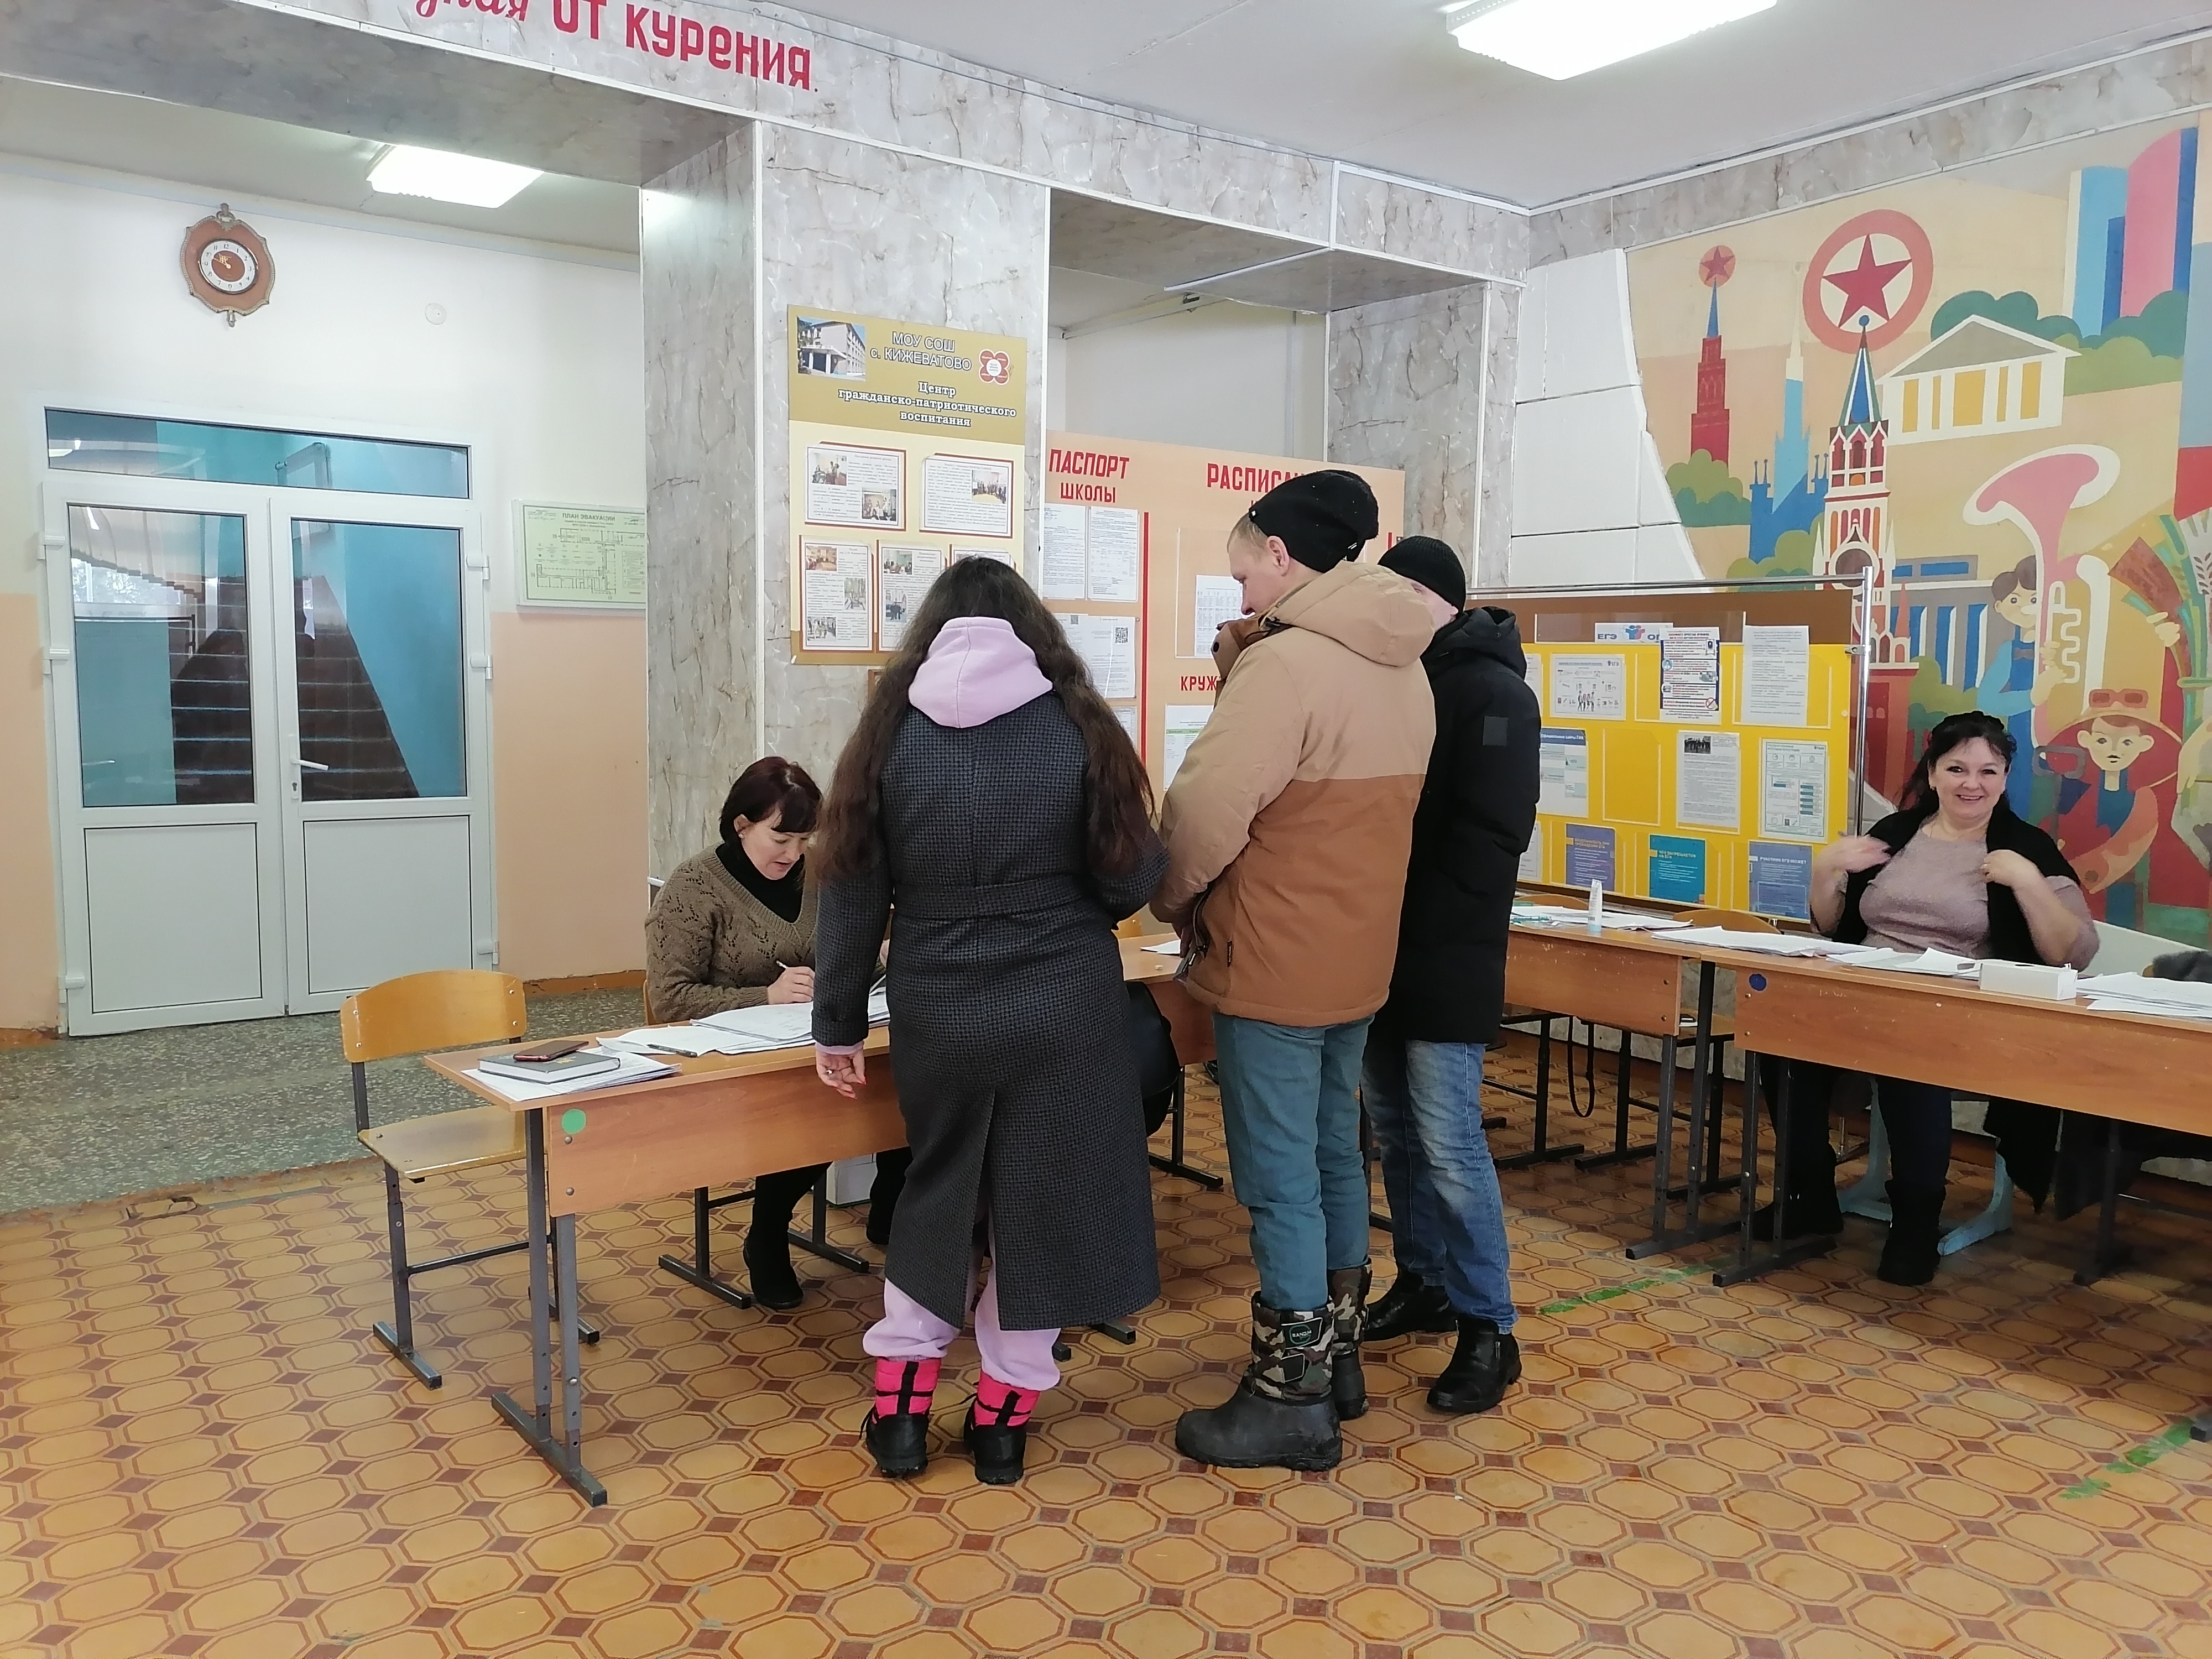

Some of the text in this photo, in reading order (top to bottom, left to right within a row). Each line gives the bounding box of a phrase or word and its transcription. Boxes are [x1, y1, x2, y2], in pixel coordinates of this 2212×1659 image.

[892, 332, 955, 352] МОУ СОШ
[870, 348, 880, 359] с.
[884, 347, 972, 371] КИЖЕВАТОВО
[918, 381, 956, 398] Центр
[838, 388, 1017, 417] гражданско-патриотического
[899, 410, 971, 427] воспитания
[1048, 448, 1130, 479] ПАСПОРТ
[1207, 462, 1305, 493] РАСПИС
[1060, 482, 1116, 503] ШКОЛЫ
[1181, 676, 1217, 691] КРУЖ
